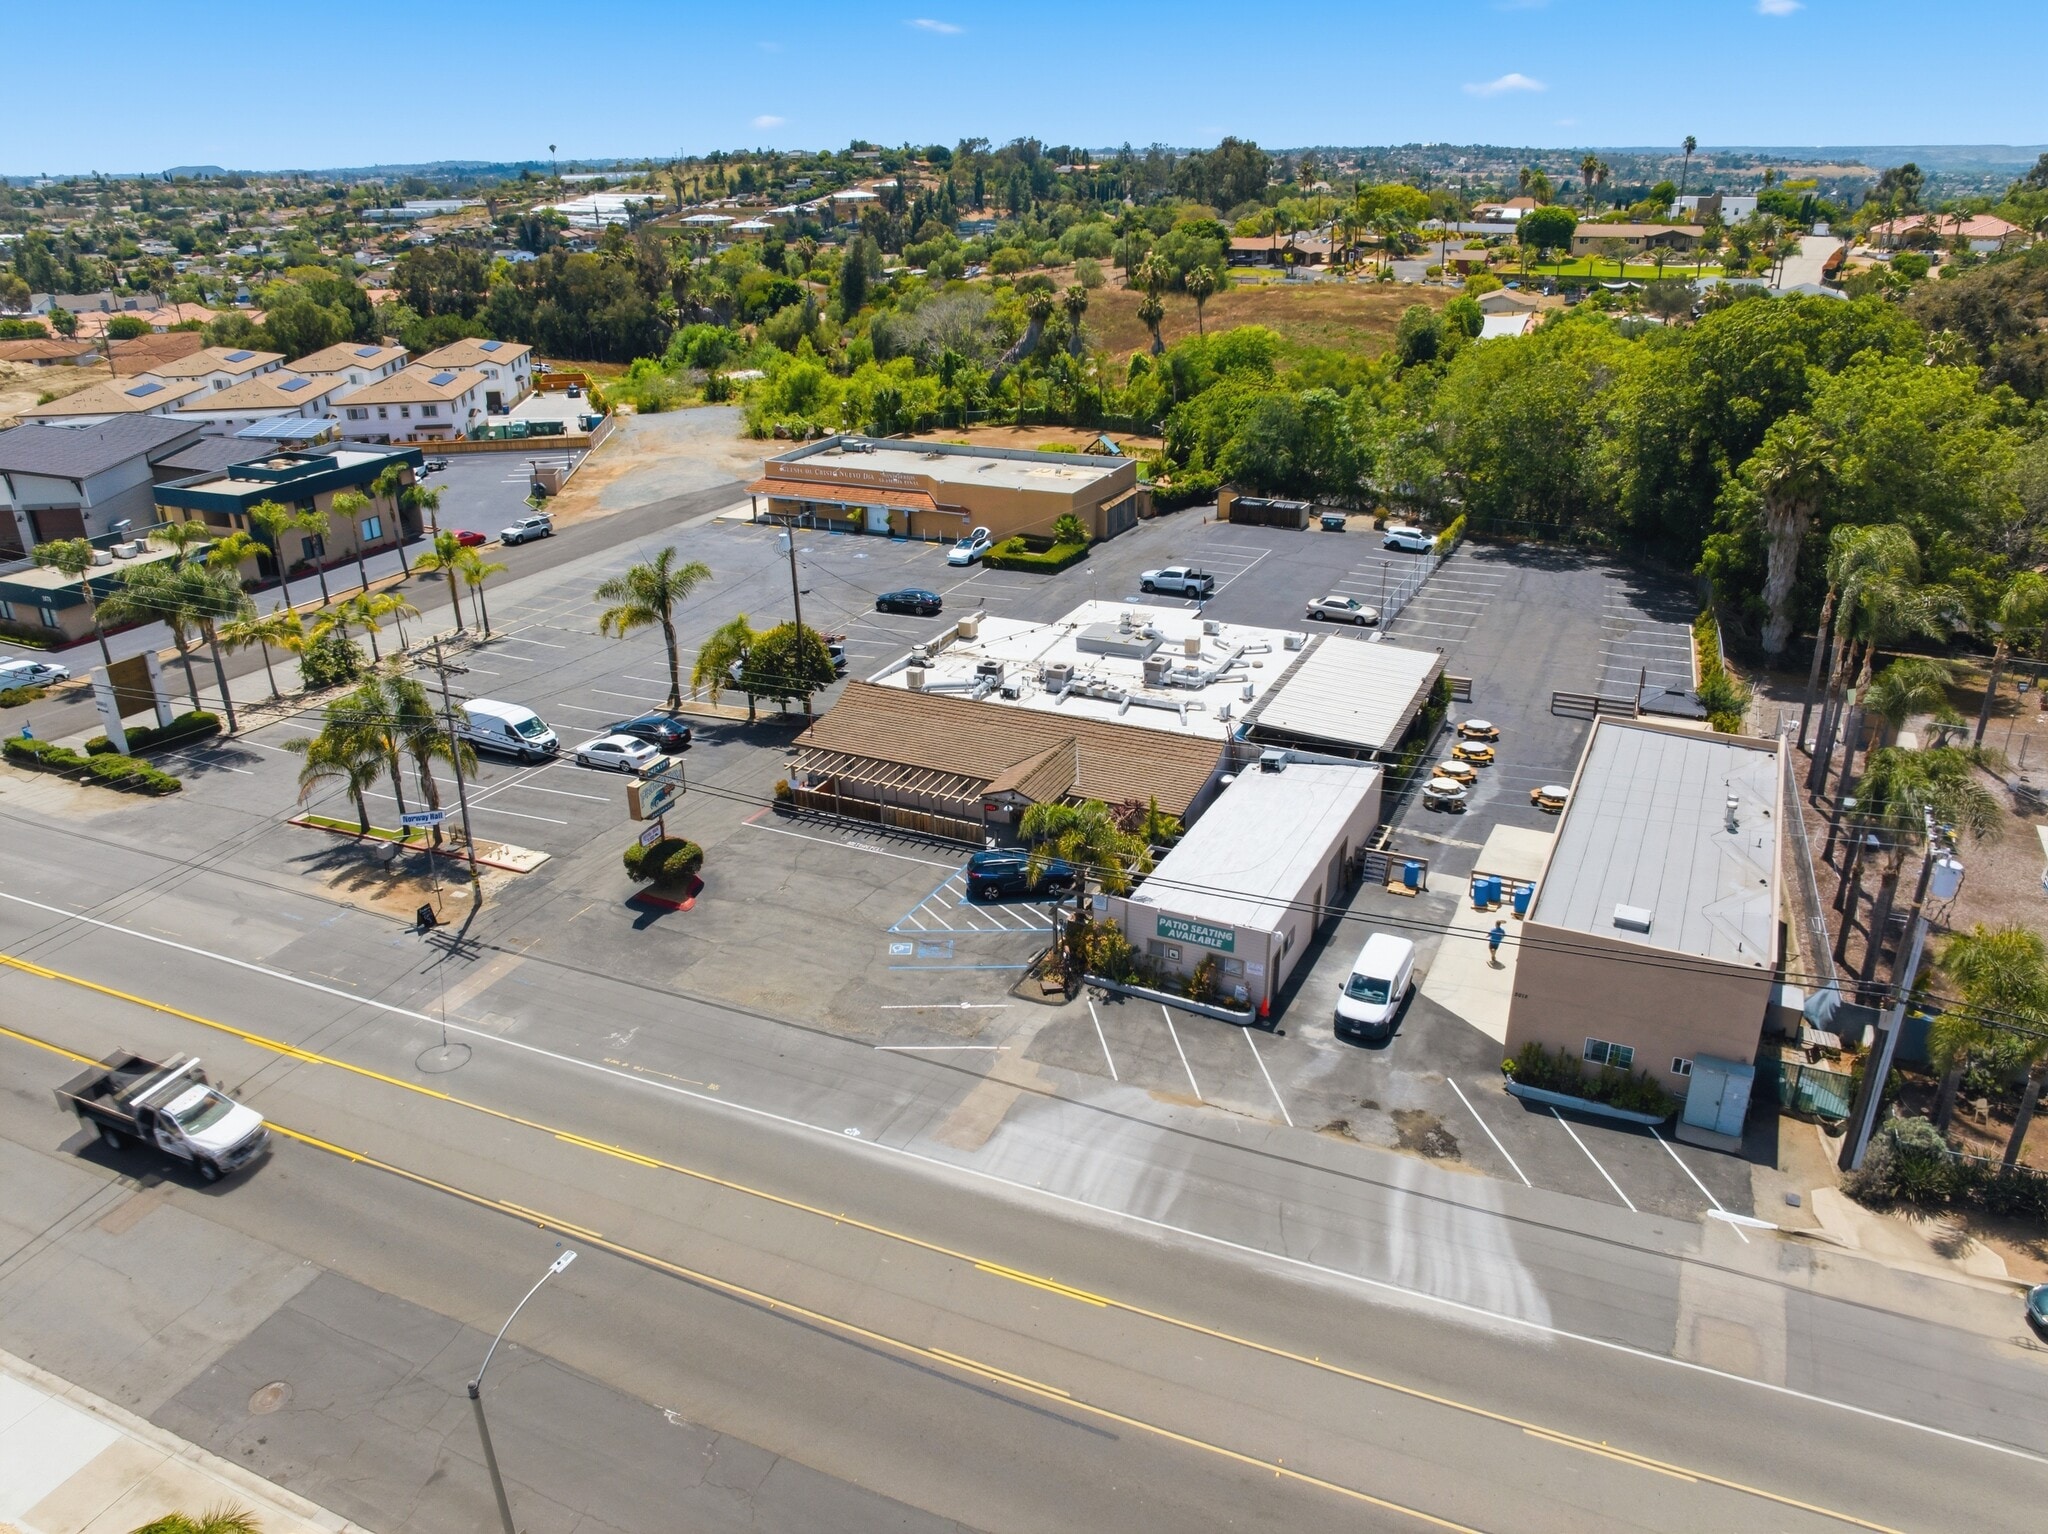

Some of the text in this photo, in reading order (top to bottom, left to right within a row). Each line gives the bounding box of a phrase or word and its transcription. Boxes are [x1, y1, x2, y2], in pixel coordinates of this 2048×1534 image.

[780, 465, 803, 475] GLESIA
[402, 811, 443, 823] Norway Hall
[1159, 918, 1233, 941] PATIO SEATING
[1167, 929, 1223, 948] AVAILABLE
